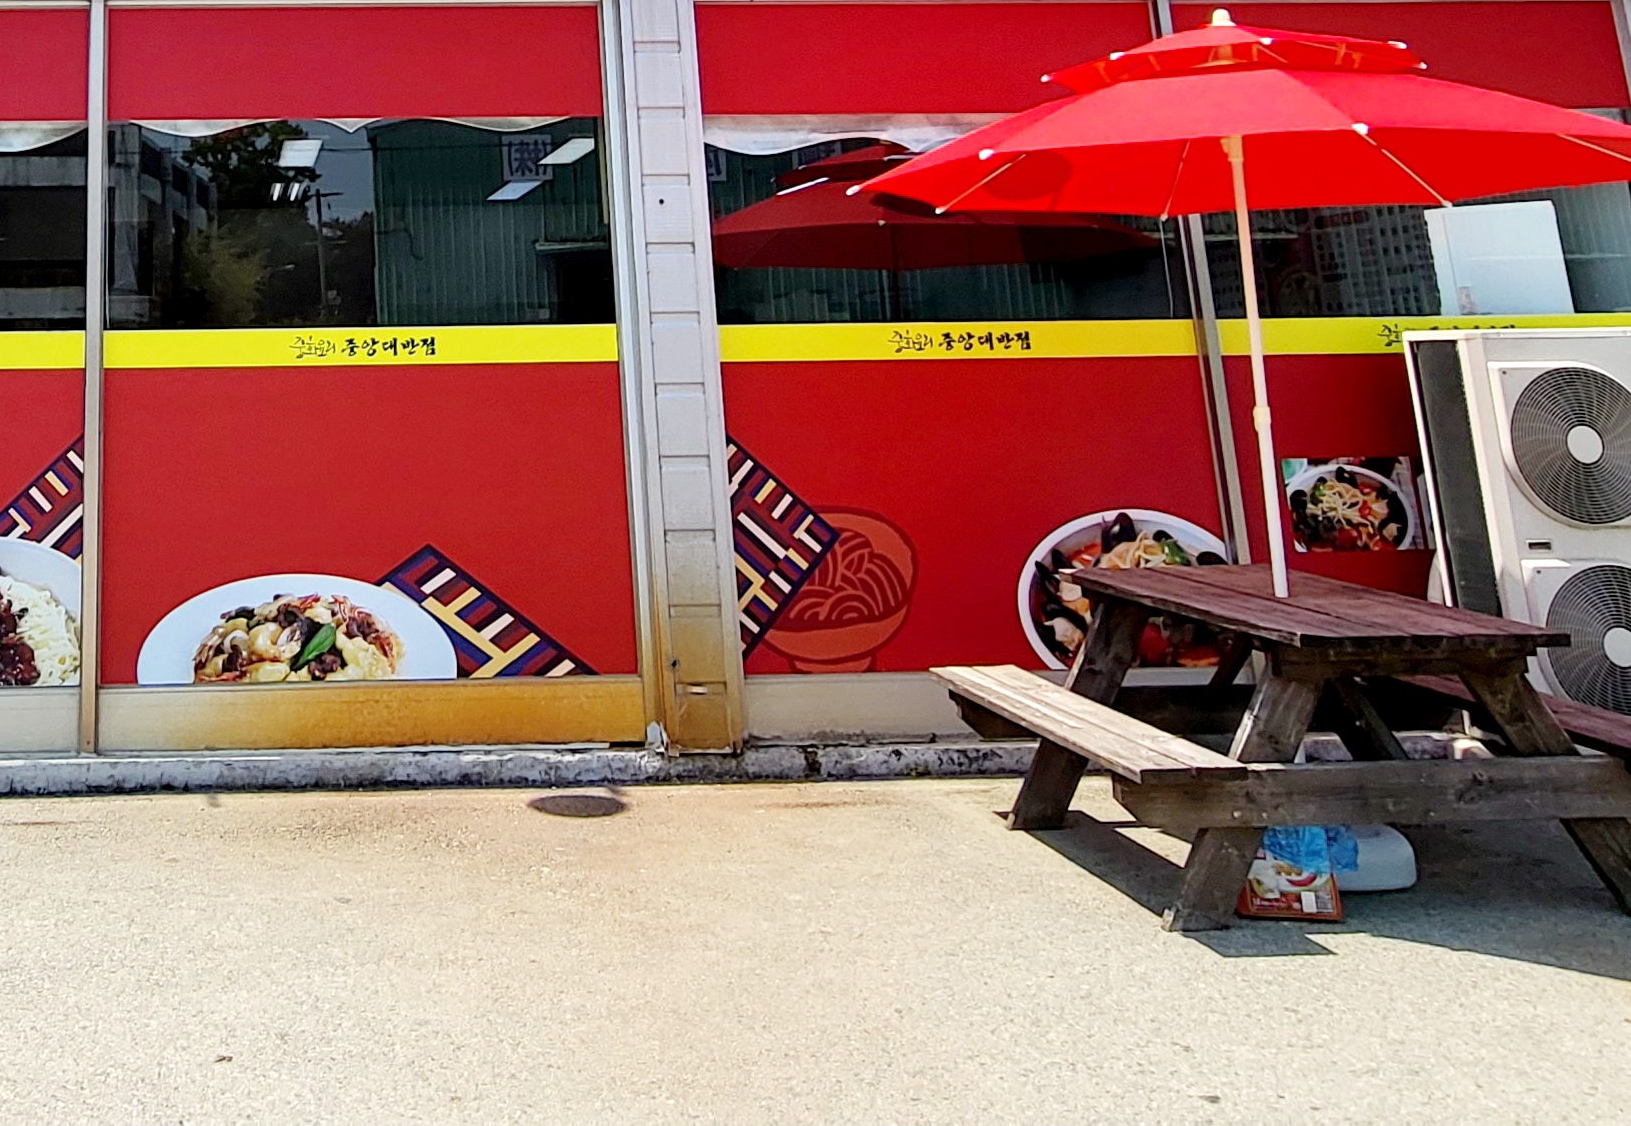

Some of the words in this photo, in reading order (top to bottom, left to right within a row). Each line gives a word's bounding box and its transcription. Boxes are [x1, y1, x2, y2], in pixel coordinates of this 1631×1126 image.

[289, 335, 336, 359] 중화요리
[341, 337, 437, 357] 중앙대반점
[888, 330, 934, 354] 중화요리
[939, 331, 1032, 351] 중앙대반점
